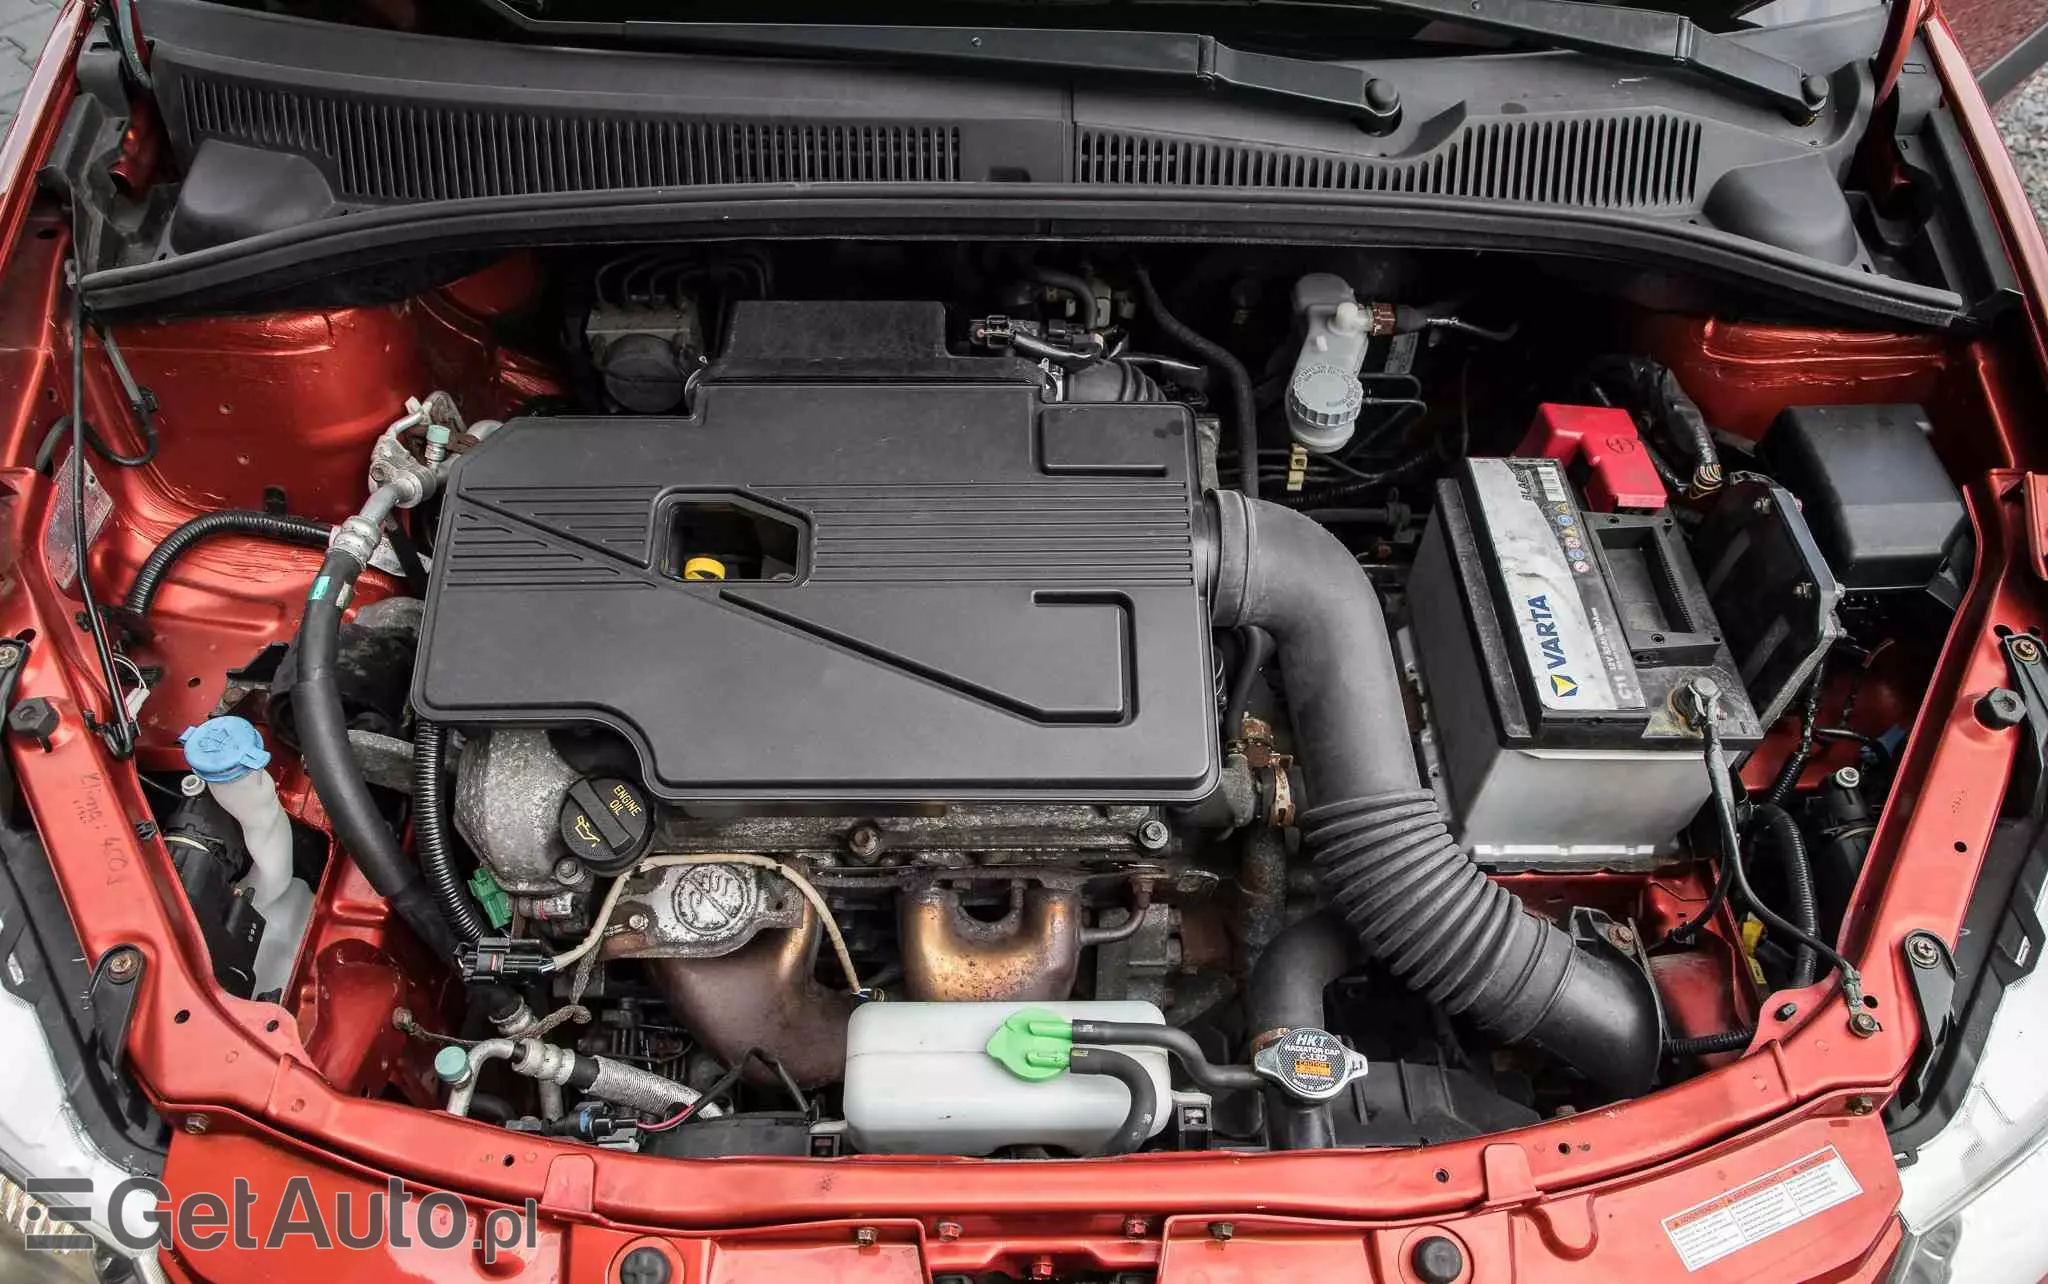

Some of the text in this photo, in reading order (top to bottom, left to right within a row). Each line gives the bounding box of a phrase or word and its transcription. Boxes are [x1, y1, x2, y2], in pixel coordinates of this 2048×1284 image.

[1527, 594, 1567, 670] VARTA
[610, 799, 624, 816] OIL
[614, 784, 642, 817] ENGINE
[1296, 1034, 1328, 1047] HKT
[1284, 1045, 1323, 1055] RADIATOR
